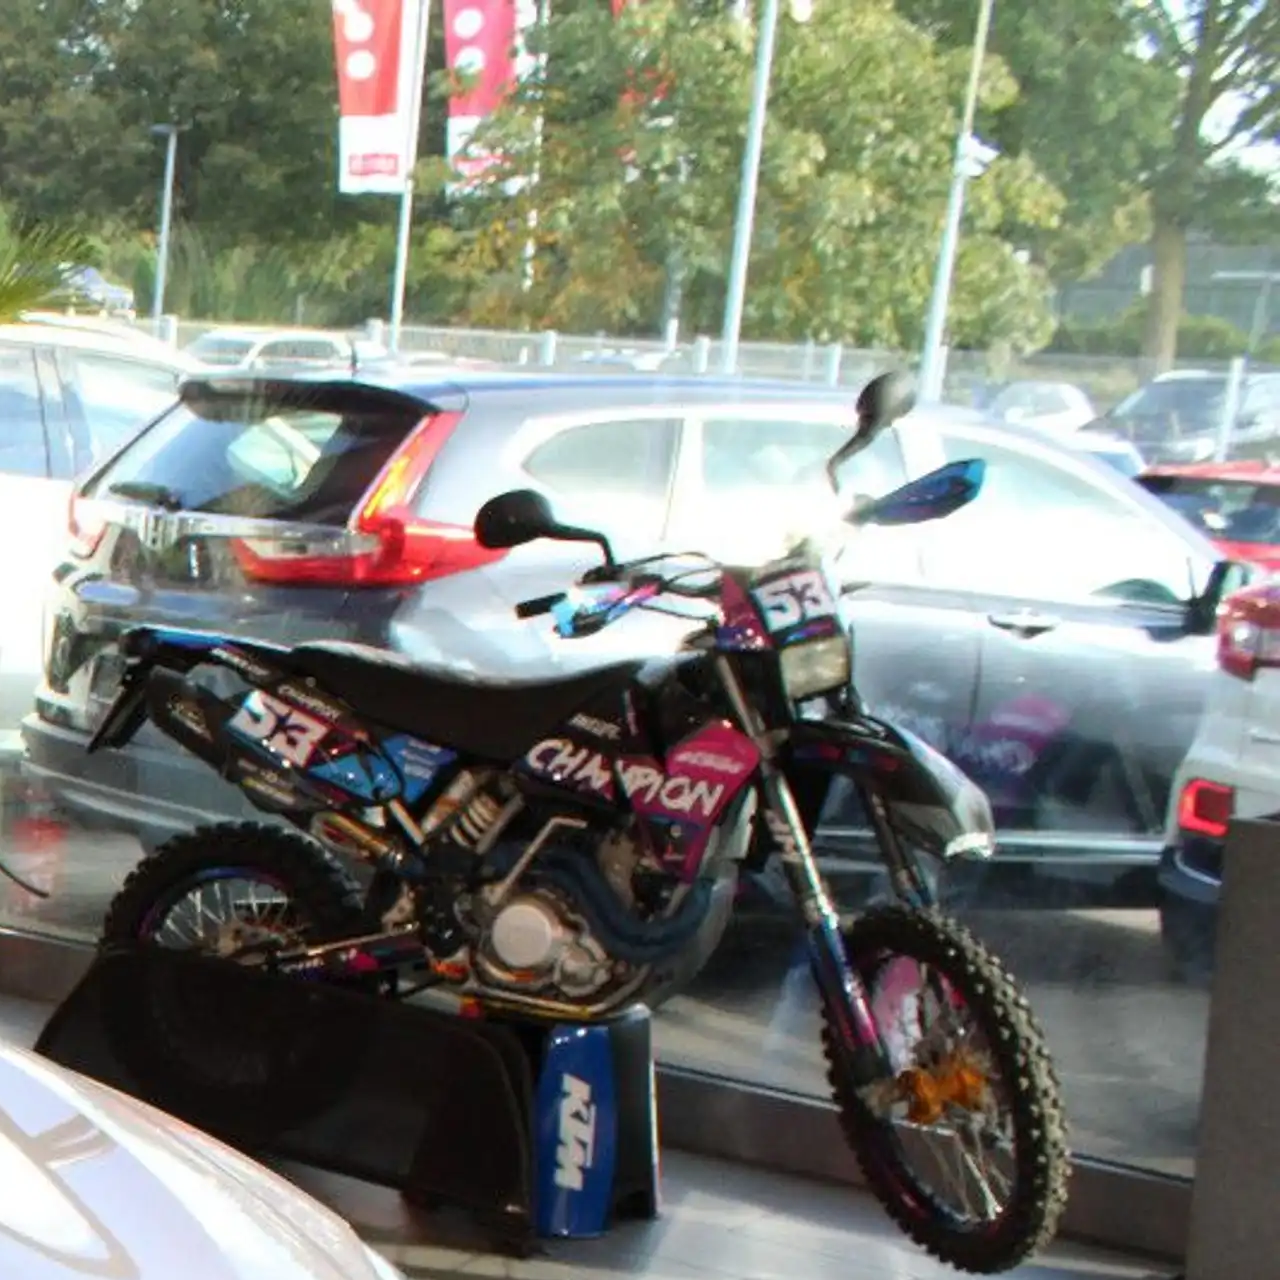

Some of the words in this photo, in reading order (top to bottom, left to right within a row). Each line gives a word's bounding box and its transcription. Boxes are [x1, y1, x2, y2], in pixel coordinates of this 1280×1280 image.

[753, 572, 836, 632] 53
[229, 690, 329, 768] 53
[527, 738, 726, 817] CHAMPION
[553, 1072, 597, 1192] KTM
